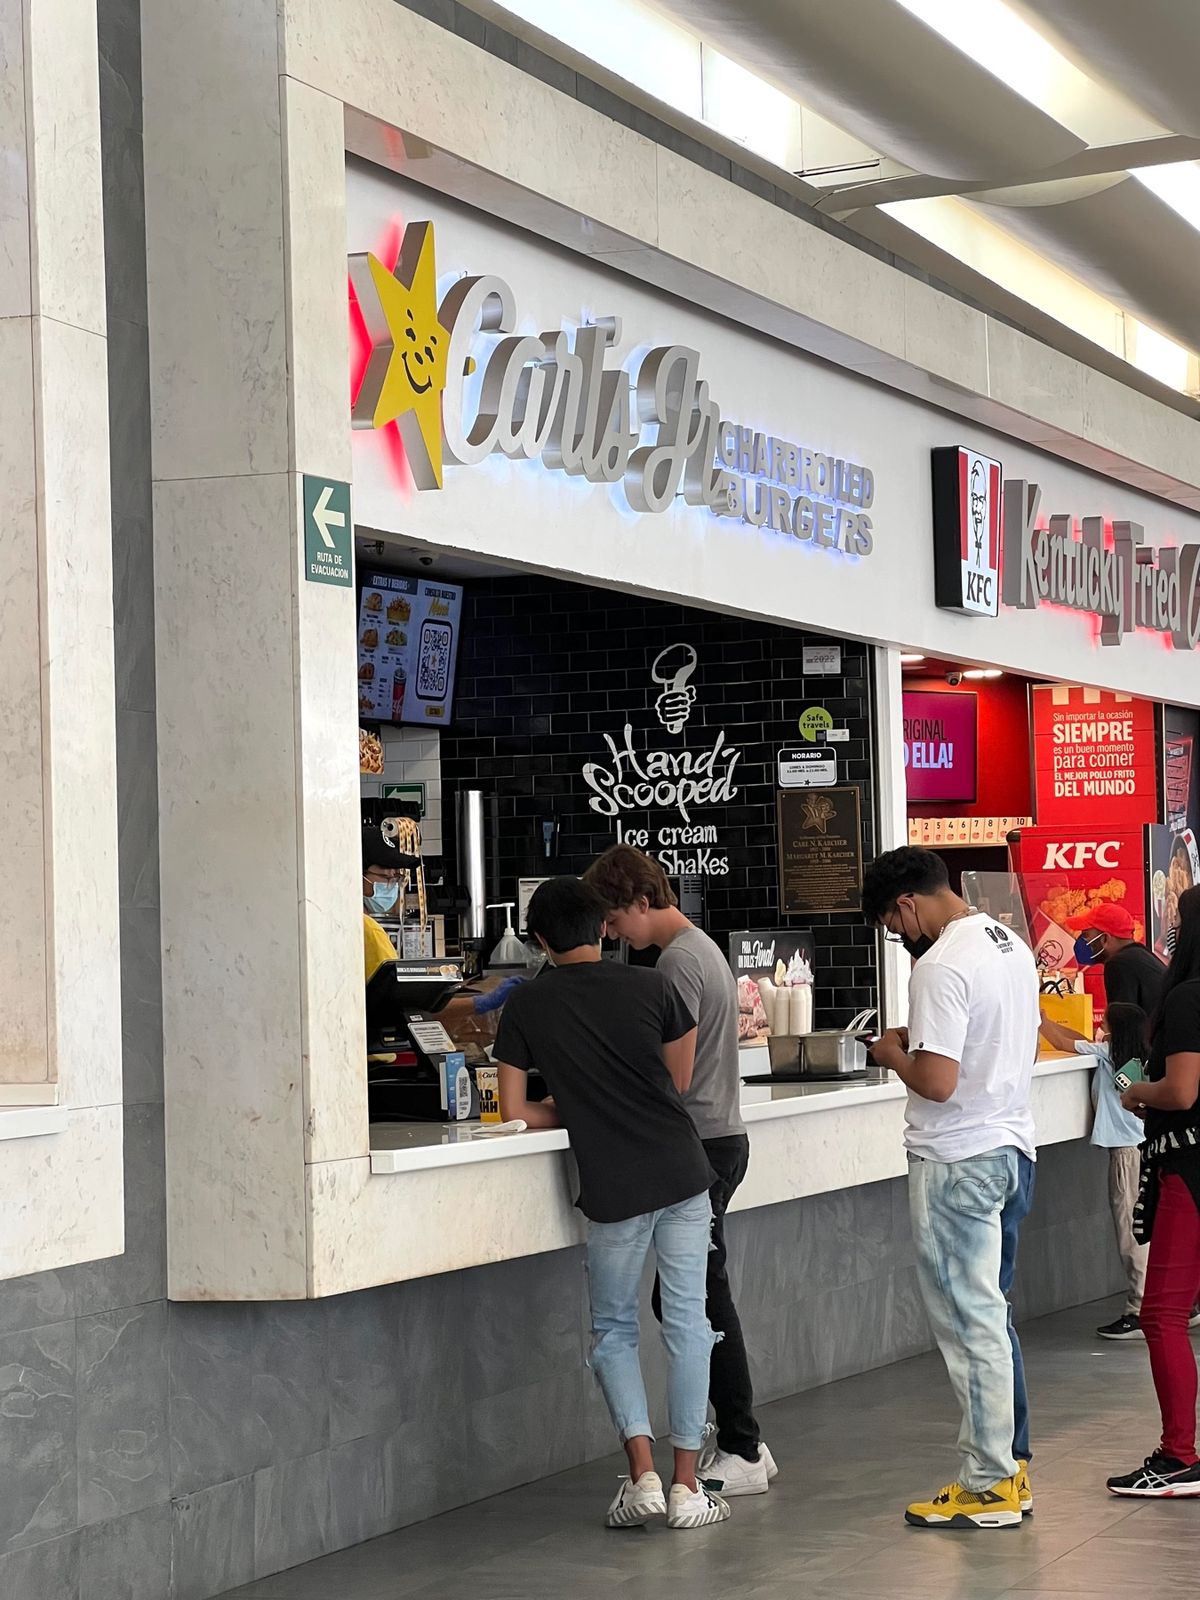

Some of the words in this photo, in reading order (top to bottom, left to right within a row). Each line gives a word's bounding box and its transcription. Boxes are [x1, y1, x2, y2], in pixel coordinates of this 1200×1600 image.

[718, 421, 874, 509] CHARBROILED
[720, 471, 873, 556] BURGERS
[316, 552, 332, 563] RUTA
[334, 554, 342, 565] DE
[1005, 480, 1124, 643] Kentucky
[1113, 521, 1180, 632] Fried
[311, 563, 349, 579] EVACUACION
[966, 571, 992, 607] KFC
[813, 655, 835, 663] 2022
[802, 720, 830, 729] travels
[806, 713, 824, 721] Safe
[1053, 712, 1064, 721] Sin
[1066, 713, 1096, 722] importar
[1097, 711, 1105, 720] la
[1106, 710, 1133, 719] ocasión
[903, 719, 947, 740] RIGINAL
[1053, 721, 1133, 743] SIEMPRE
[791, 752, 822, 760] HORARIO
[912, 742, 953, 768] ELLA!
[1075, 744, 1095, 753] buen
[1097, 743, 1135, 752] momento
[1054, 755, 1085, 772] para
[1089, 752, 1135, 767] comer
[1054, 772, 1063, 780] EL
[1064, 771, 1088, 780] MEJOR
[1089, 770, 1112, 779] POLLO
[1114, 769, 1135, 778] FRITO
[583, 752, 741, 822] Scooped
[1054, 781, 1080, 797] DEL
[1083, 779, 1135, 796] MUNDO
[616, 819, 649, 847] Ice
[658, 825, 718, 846] cream
[924, 822, 929, 830] 2
[948, 821, 954, 829] 4
[988, 819, 993, 827] 8
[1042, 841, 1120, 869] KFC
[480, 1101, 498, 1113] HH
